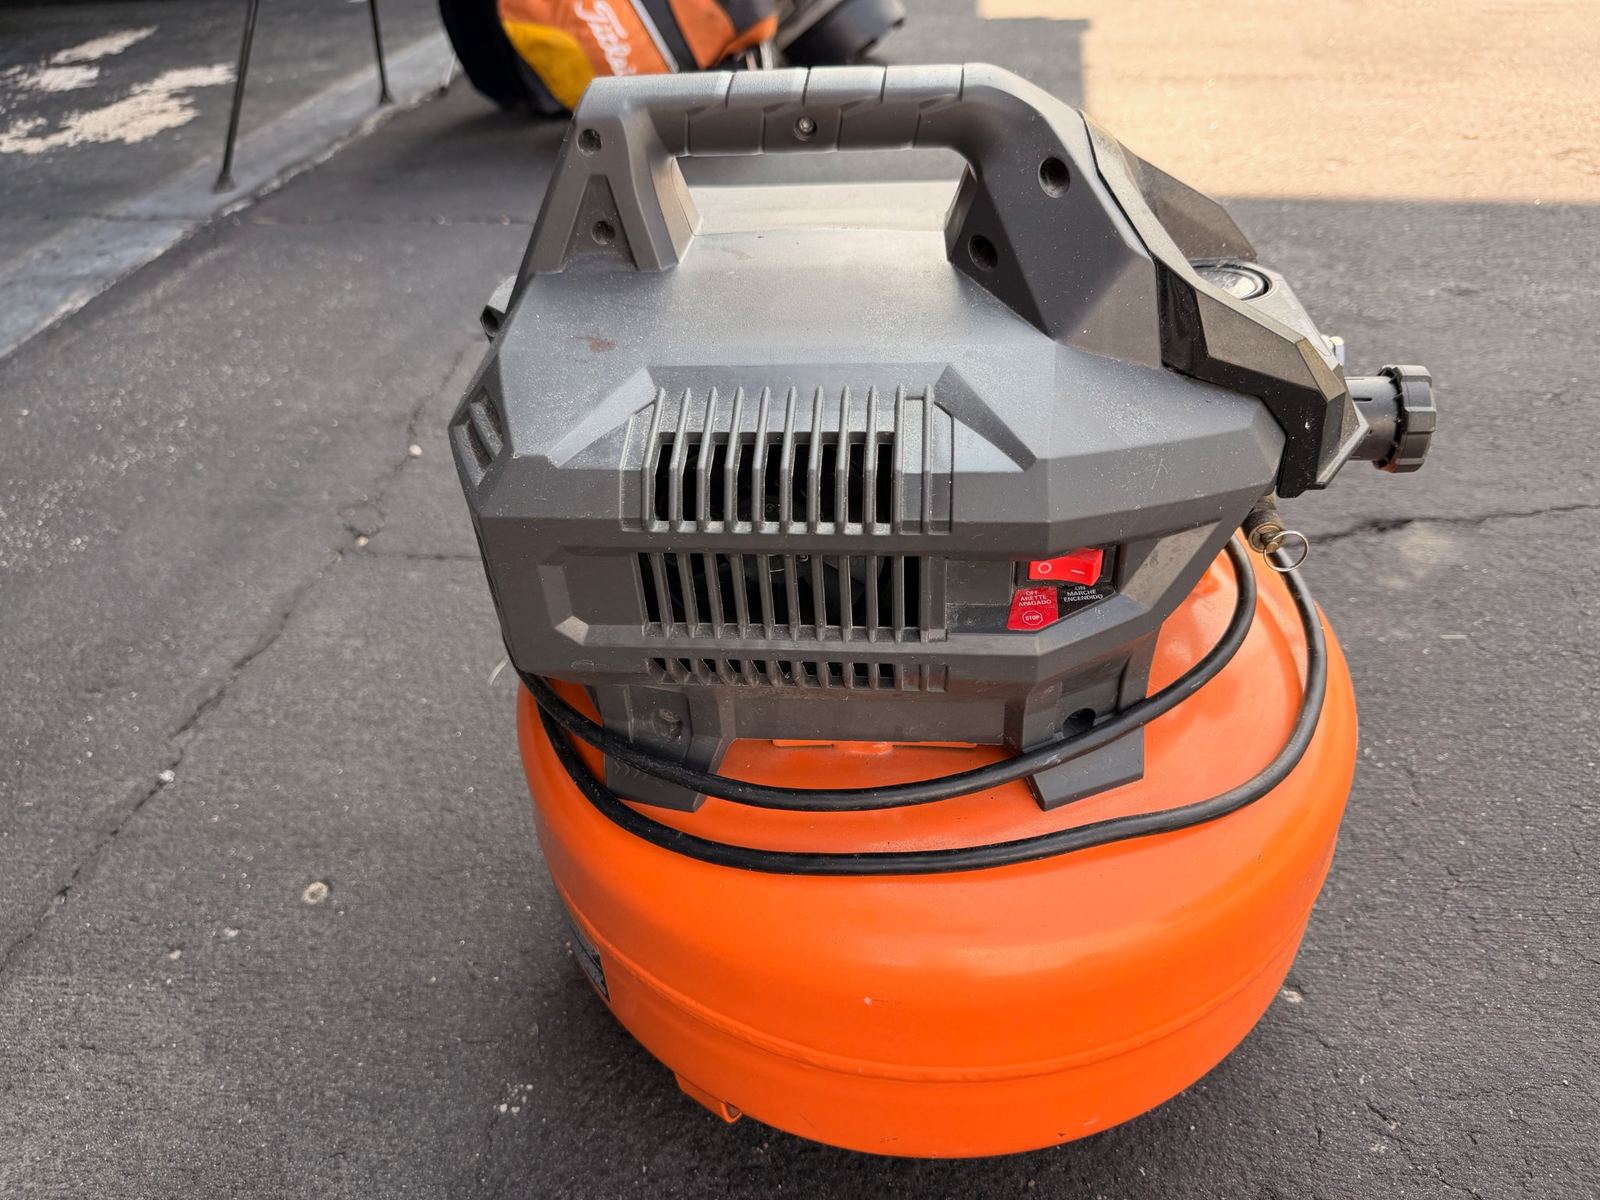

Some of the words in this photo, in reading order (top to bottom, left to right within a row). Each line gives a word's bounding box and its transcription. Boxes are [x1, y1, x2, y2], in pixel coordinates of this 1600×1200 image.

[1066, 589, 1097, 597] MARCHE
[1063, 594, 1103, 603] ENCENDIDO
[1018, 599, 1052, 607] APAGADO
